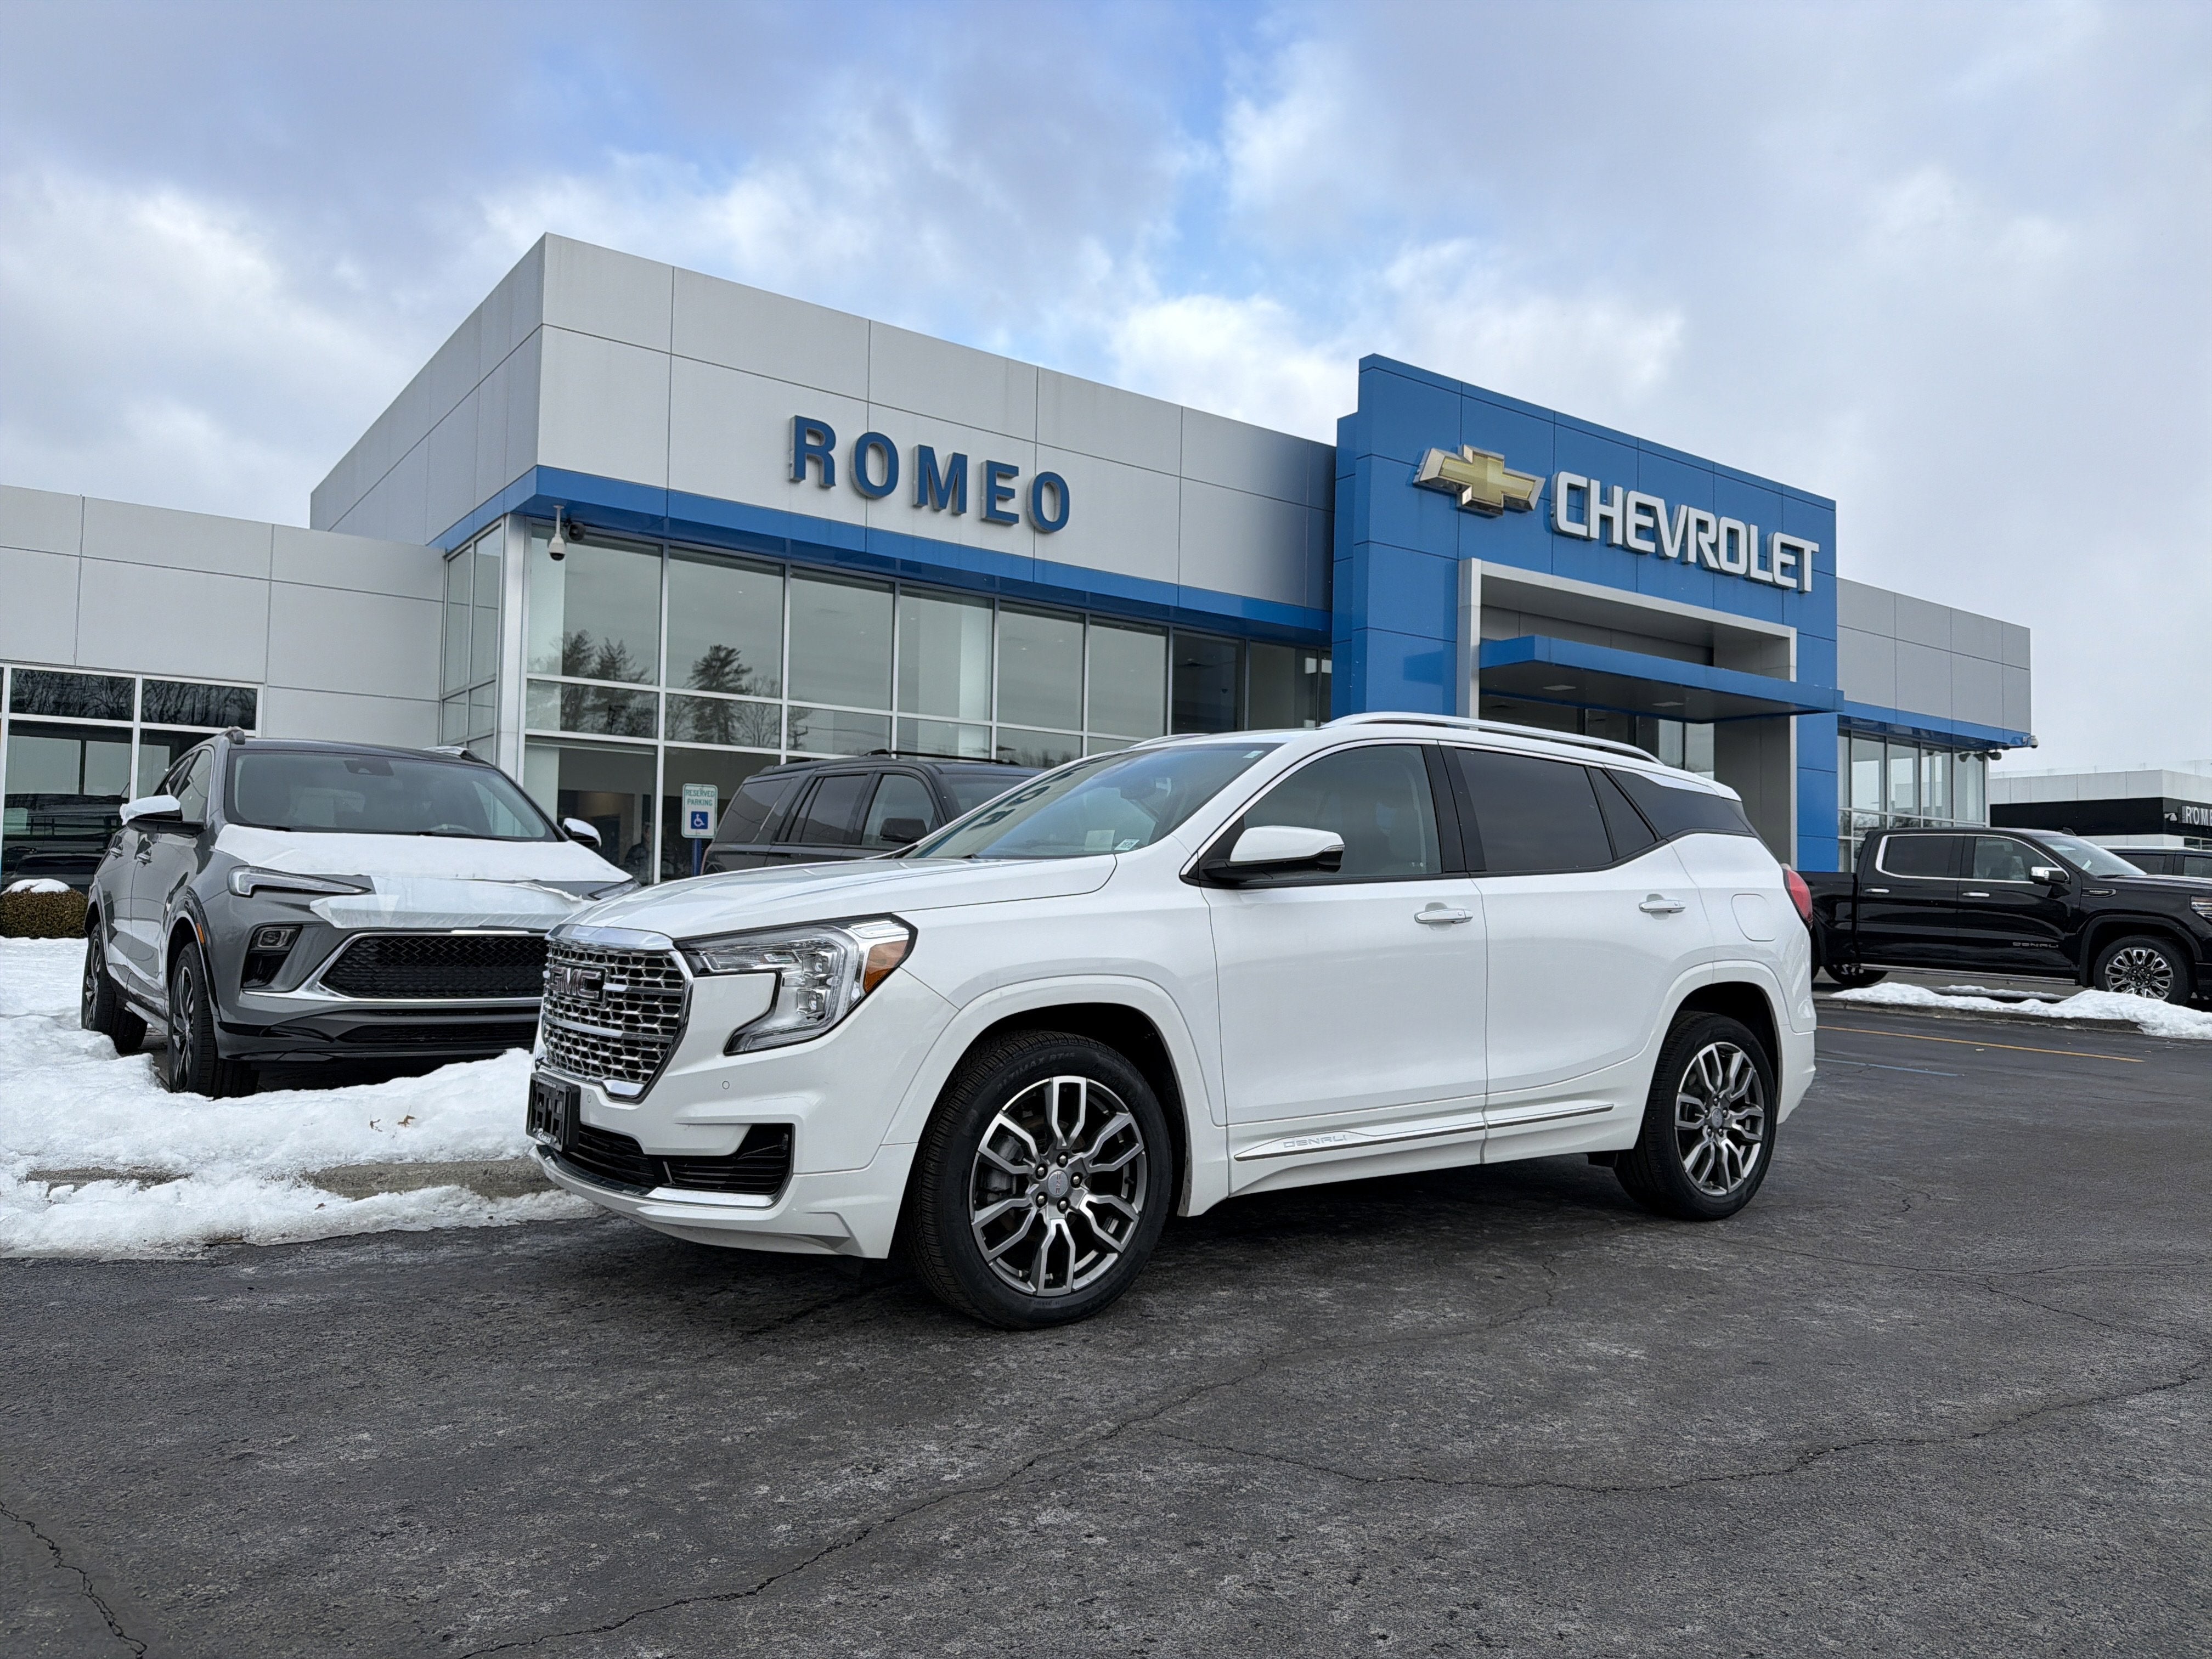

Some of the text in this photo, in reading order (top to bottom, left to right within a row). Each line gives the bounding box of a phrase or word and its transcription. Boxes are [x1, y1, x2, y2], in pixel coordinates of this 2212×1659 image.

[790, 415, 1070, 533] ROMEO
[1551, 471, 1819, 592] CHEVROLET
[549, 966, 601, 1000] GMC
[1283, 1135, 1347, 1148] DENALI
